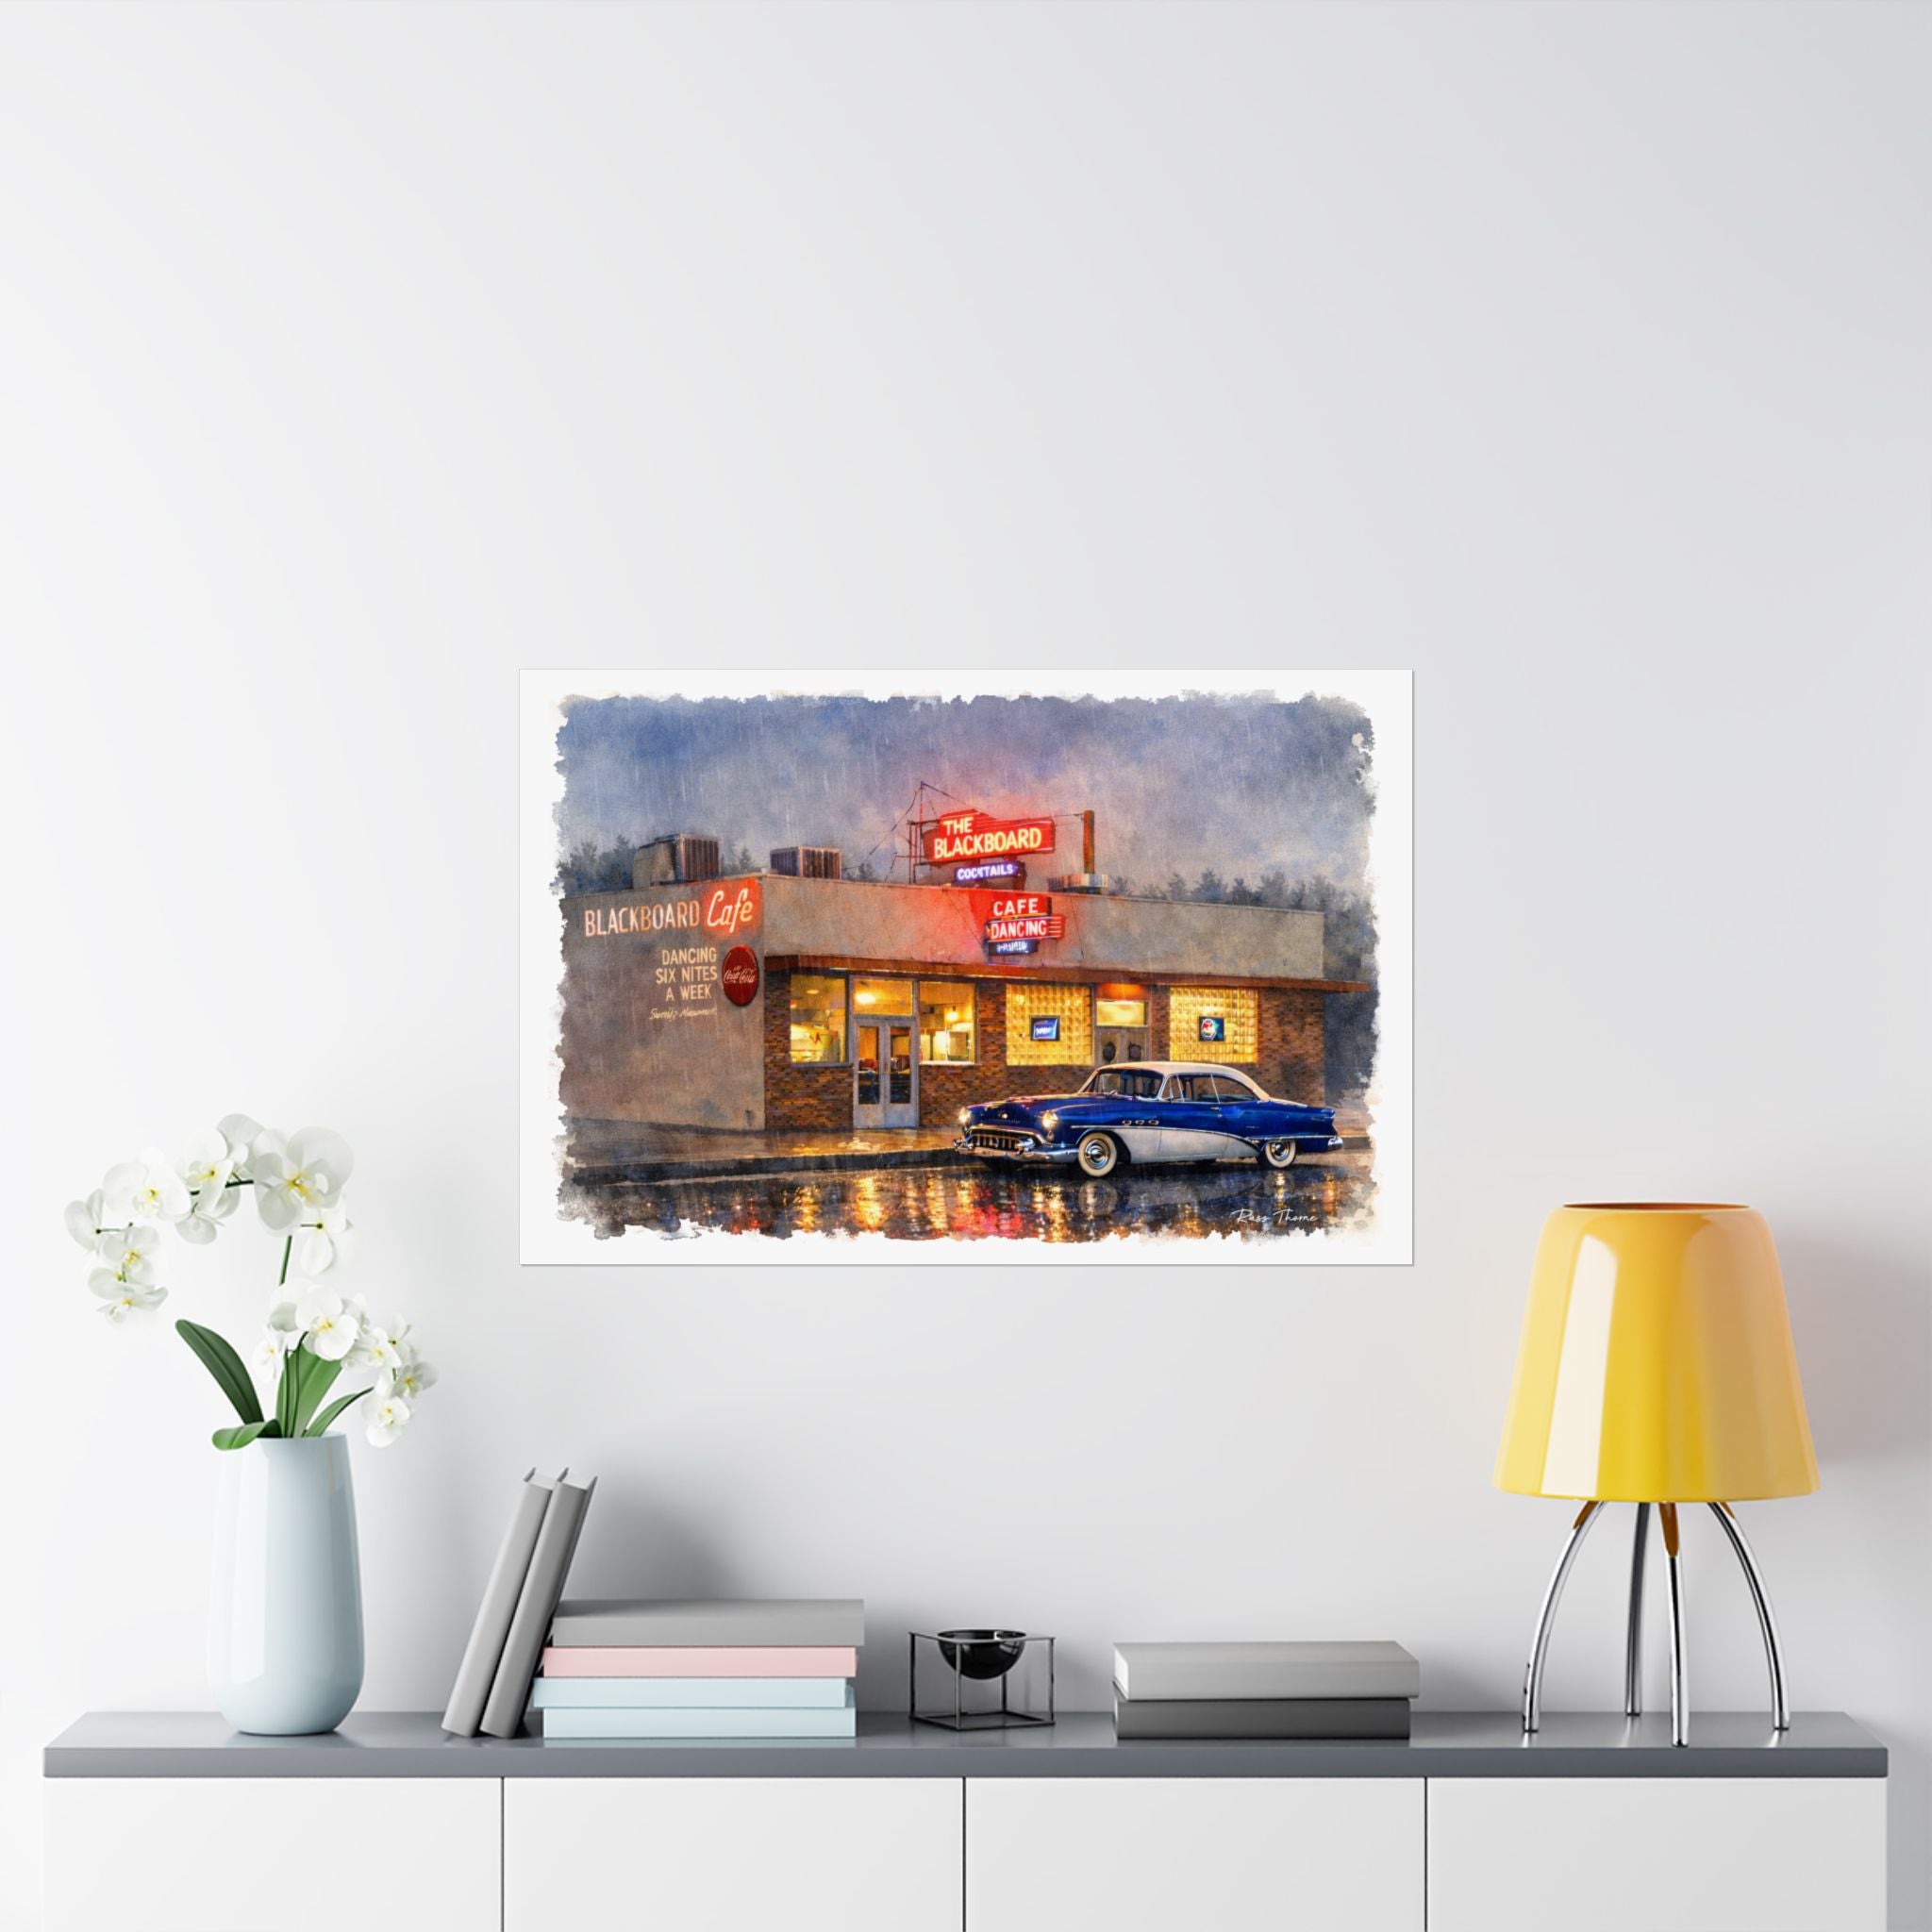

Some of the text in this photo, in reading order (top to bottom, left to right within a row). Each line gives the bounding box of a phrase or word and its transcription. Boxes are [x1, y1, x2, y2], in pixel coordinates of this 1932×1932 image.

[942, 816, 974, 836] THE
[934, 827, 1042, 859] BLACKBOARD
[957, 863, 1014, 880] COCKTAILS
[993, 897, 1039, 916] CAFE
[584, 899, 701, 938] BLACKBOARD
[991, 919, 1047, 940] DANCING
[661, 947, 717, 966] DANCING
[655, 965, 718, 985] SIX NITES
[665, 984, 712, 1002] A WEEK
